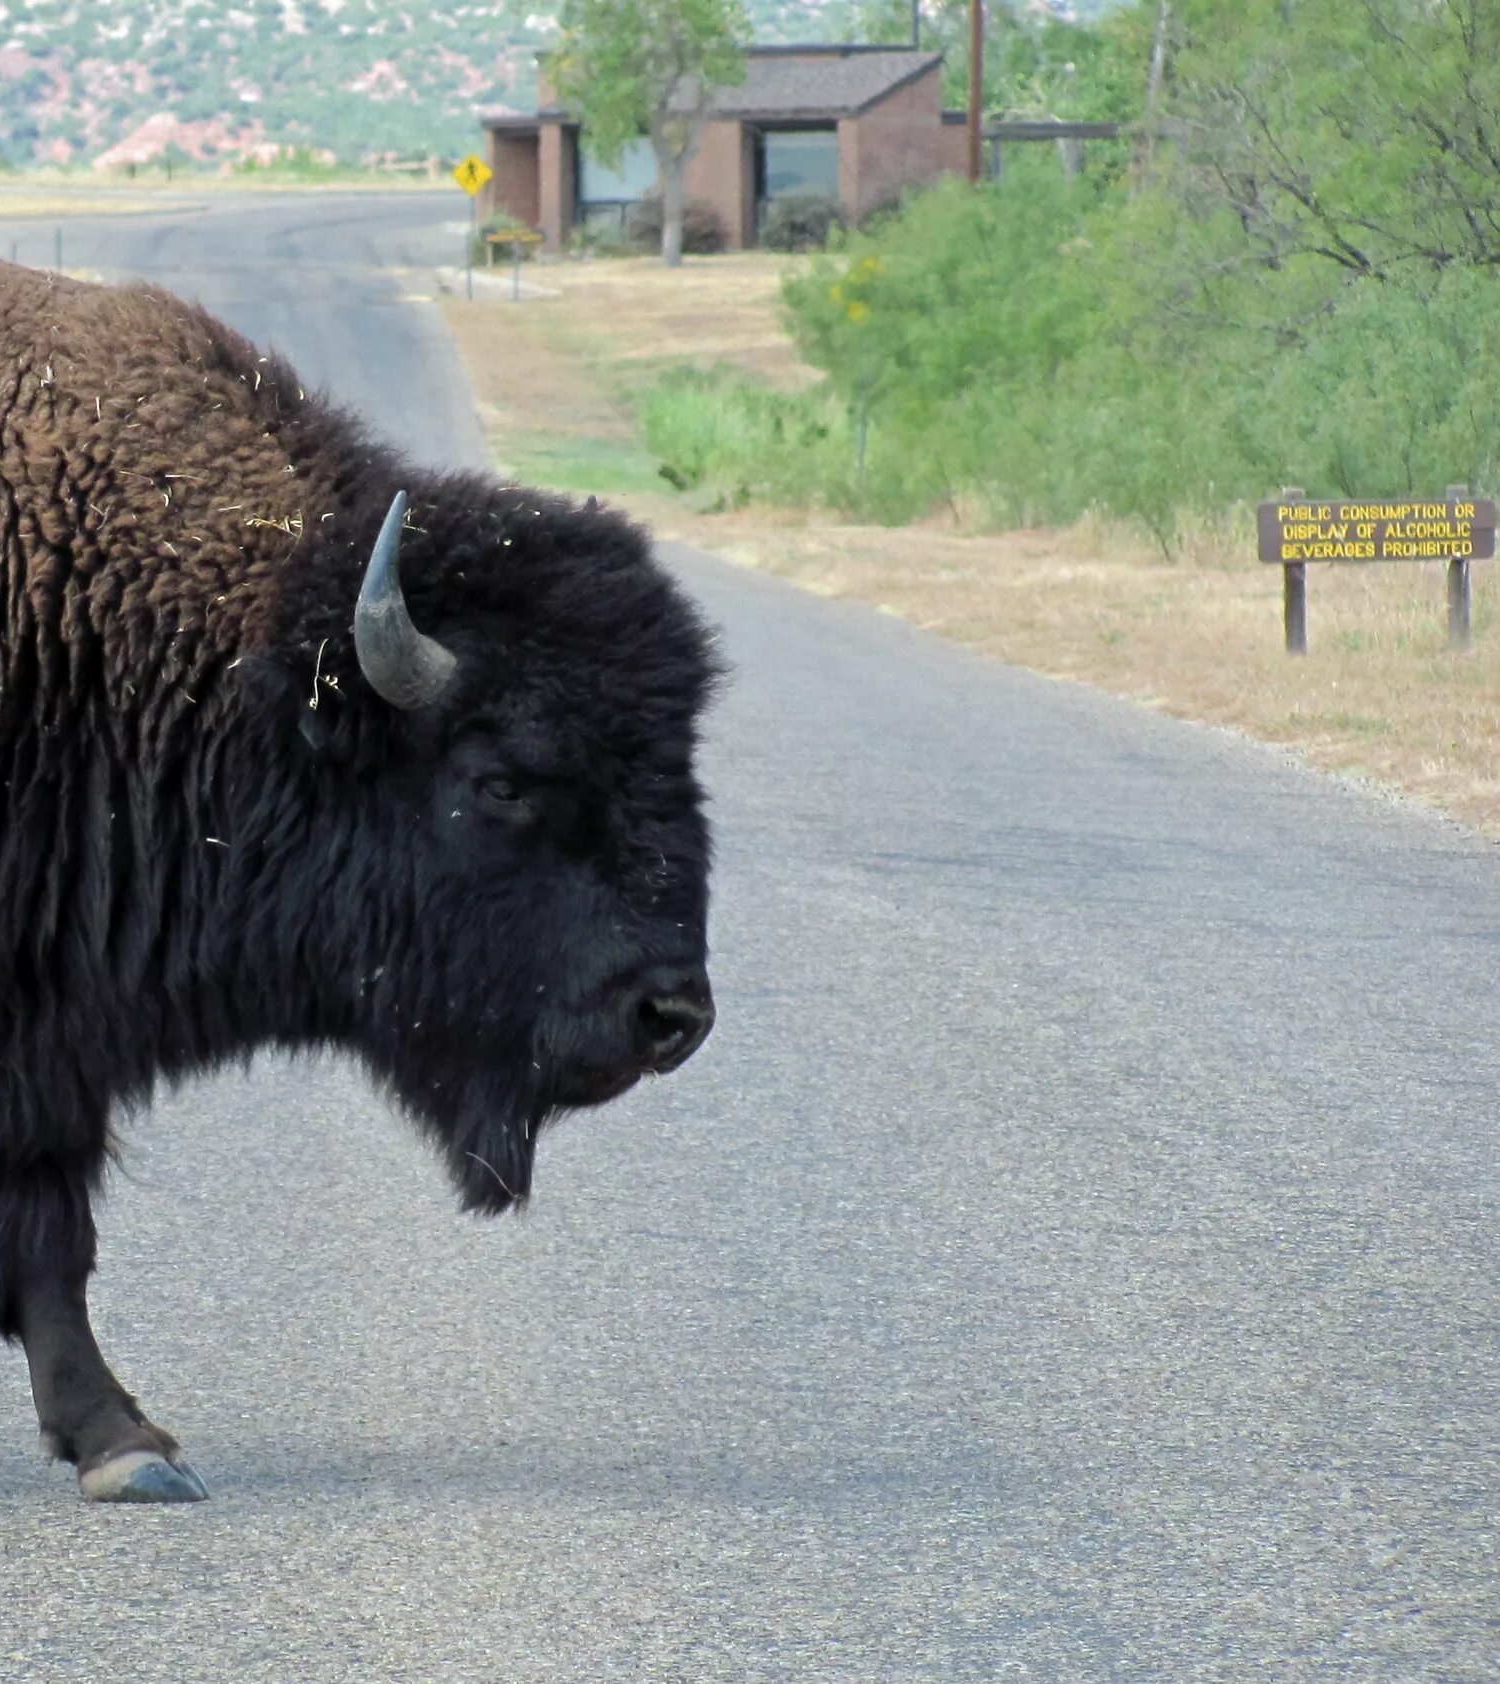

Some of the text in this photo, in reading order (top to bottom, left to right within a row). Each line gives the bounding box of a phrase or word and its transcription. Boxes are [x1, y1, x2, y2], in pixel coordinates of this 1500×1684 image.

[1278, 504, 1475, 521] PUBLIC CONSUMPTION OR
[1283, 522, 1471, 540] DISPLAY OF ALCOHOLIC
[1281, 542, 1472, 559] BEVERAGES PROHIBITED
